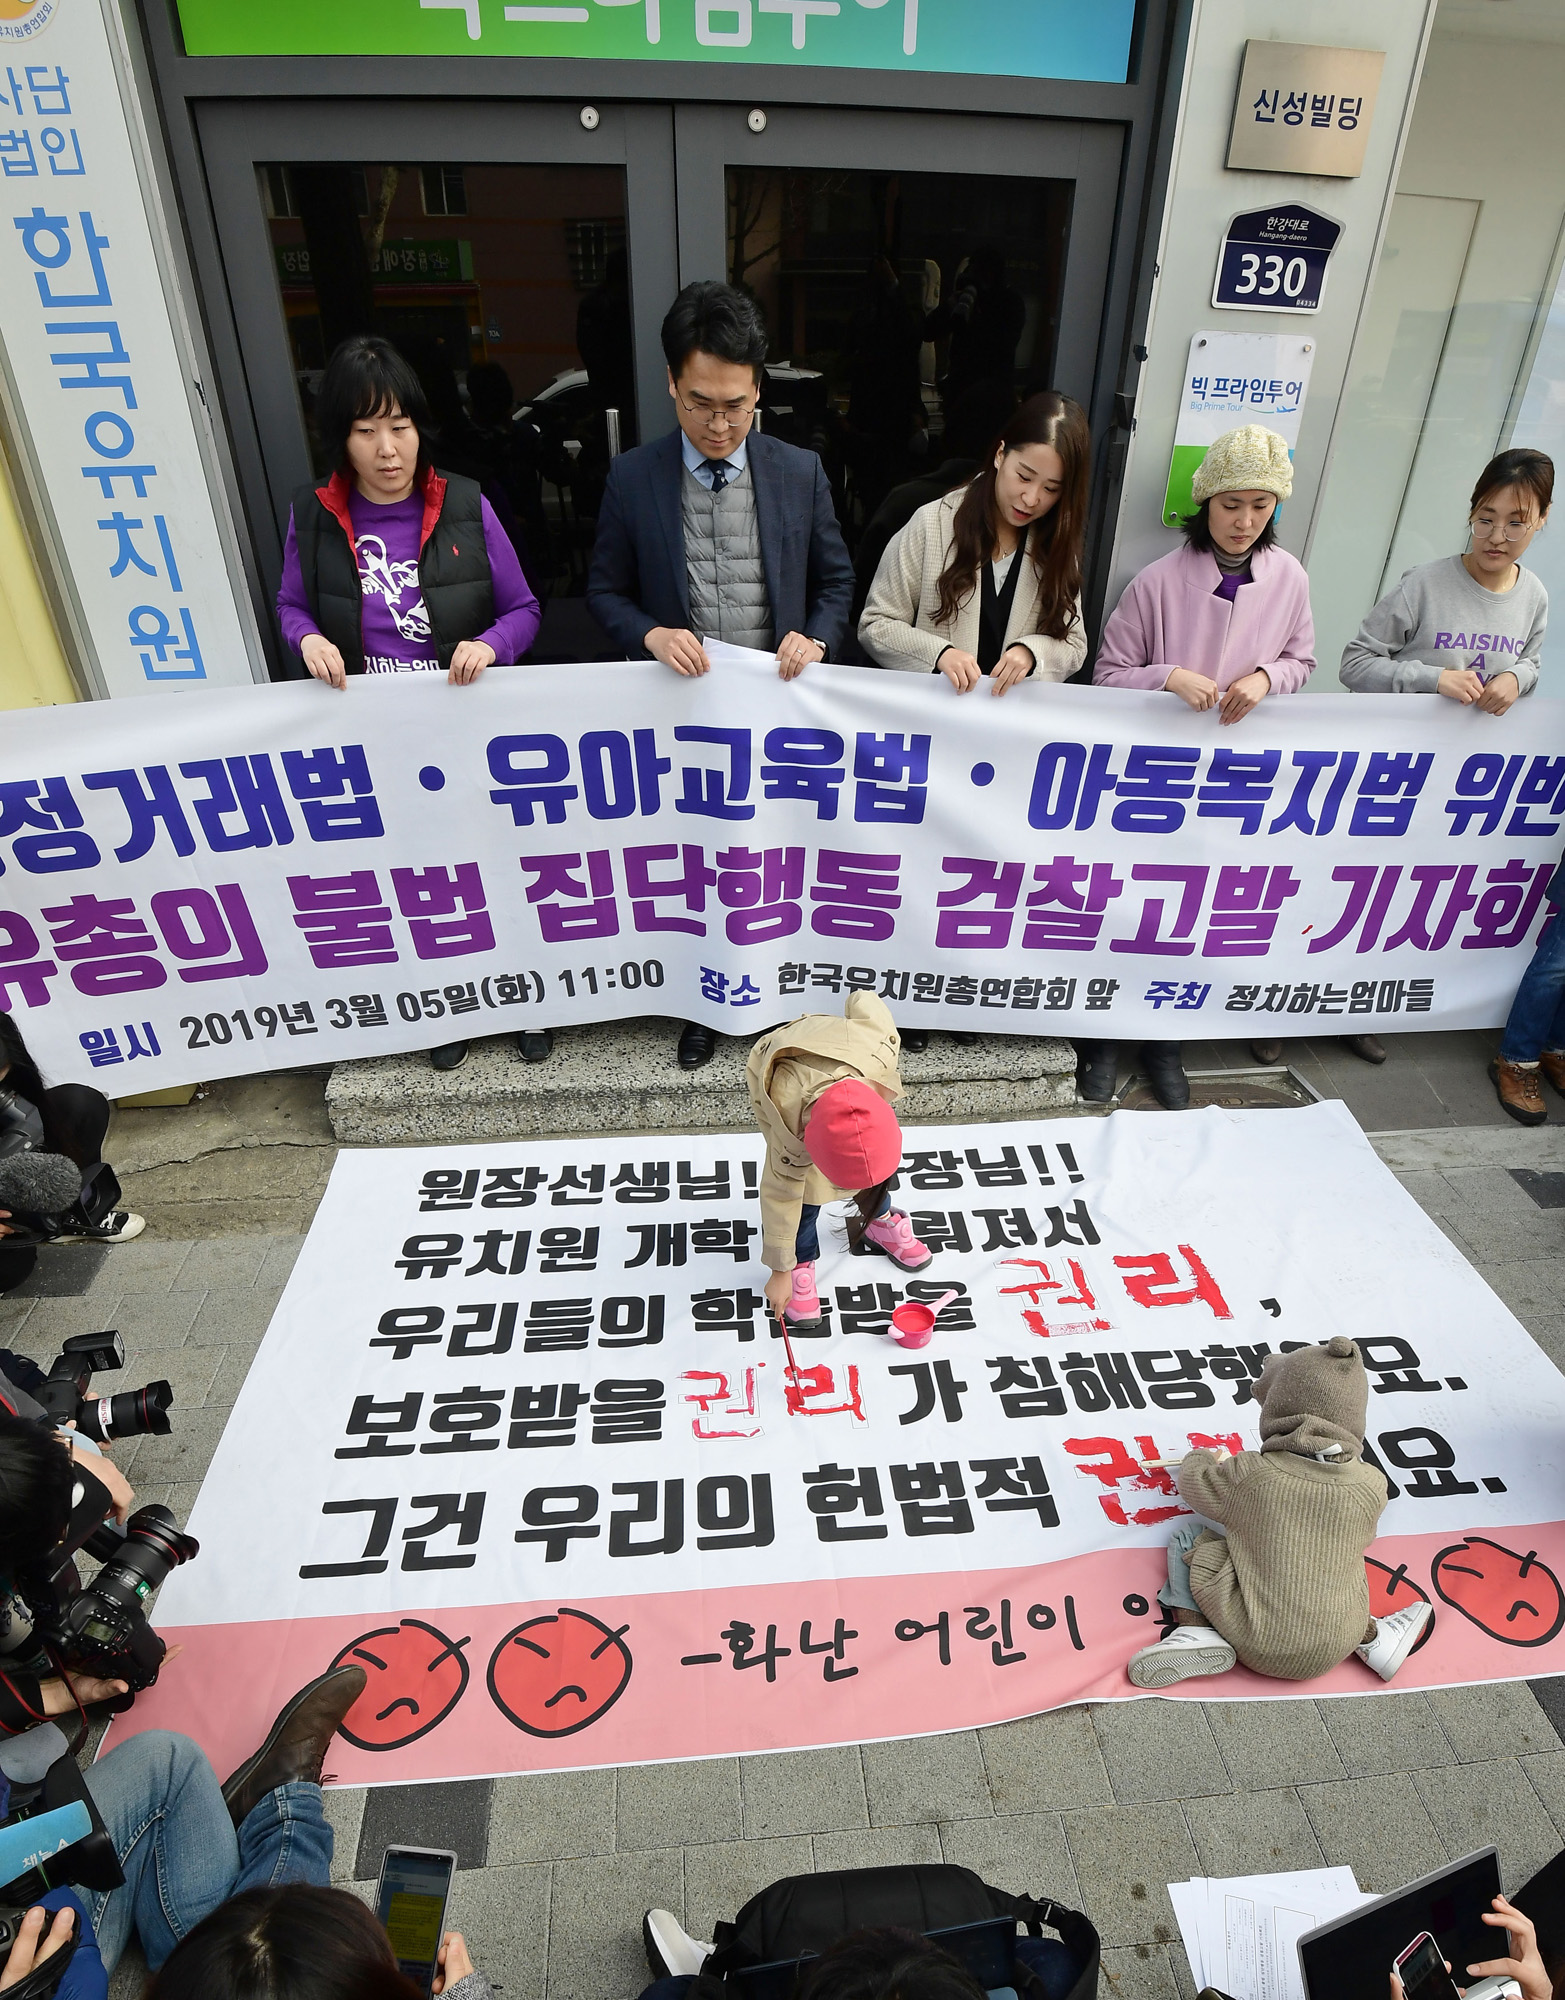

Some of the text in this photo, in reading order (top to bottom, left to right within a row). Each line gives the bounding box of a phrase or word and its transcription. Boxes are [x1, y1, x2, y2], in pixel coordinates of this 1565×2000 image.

[1253, 89, 1363, 131] 신성빌딩
[0, 127, 86, 176] 법인
[1259, 231, 1307, 241] Hangang-daero
[1266, 216, 1310, 232] 한강대로
[1235, 254, 1307, 297] 330
[1190, 402, 1202, 412] Big
[1204, 403, 1225, 411] Prime
[1192, 377, 1302, 405] 빅 프라임투어
[14, 208, 207, 681] 한국유치원
[1467, 653, 1485, 670] A
[486, 725, 932, 826] 유아교육법
[1028, 741, 1435, 836] 아동복지법
[1445, 753, 1565, 836] 위반
[286, 862, 496, 969] 불법
[519, 843, 902, 946] 집단행동
[934, 855, 1301, 957] 검찰고발
[79, 959, 1435, 1067] 일시 2019년 3월 05일(화) 11:00 장소 한국유치원총연합회 앞 주최 정치하는엄마들
[887, 1142, 1085, 1192] 장님!!
[394, 1225, 600, 1280] 유치원
[368, 1294, 665, 1360] 우리들의
[333, 1378, 666, 1459] 보호받을
[299, 1491, 487, 1579] 그건
[514, 1473, 775, 1562] 우리의
[802, 1455, 1060, 1542] 헌법적
[896, 1595, 1085, 1665] 어린이
